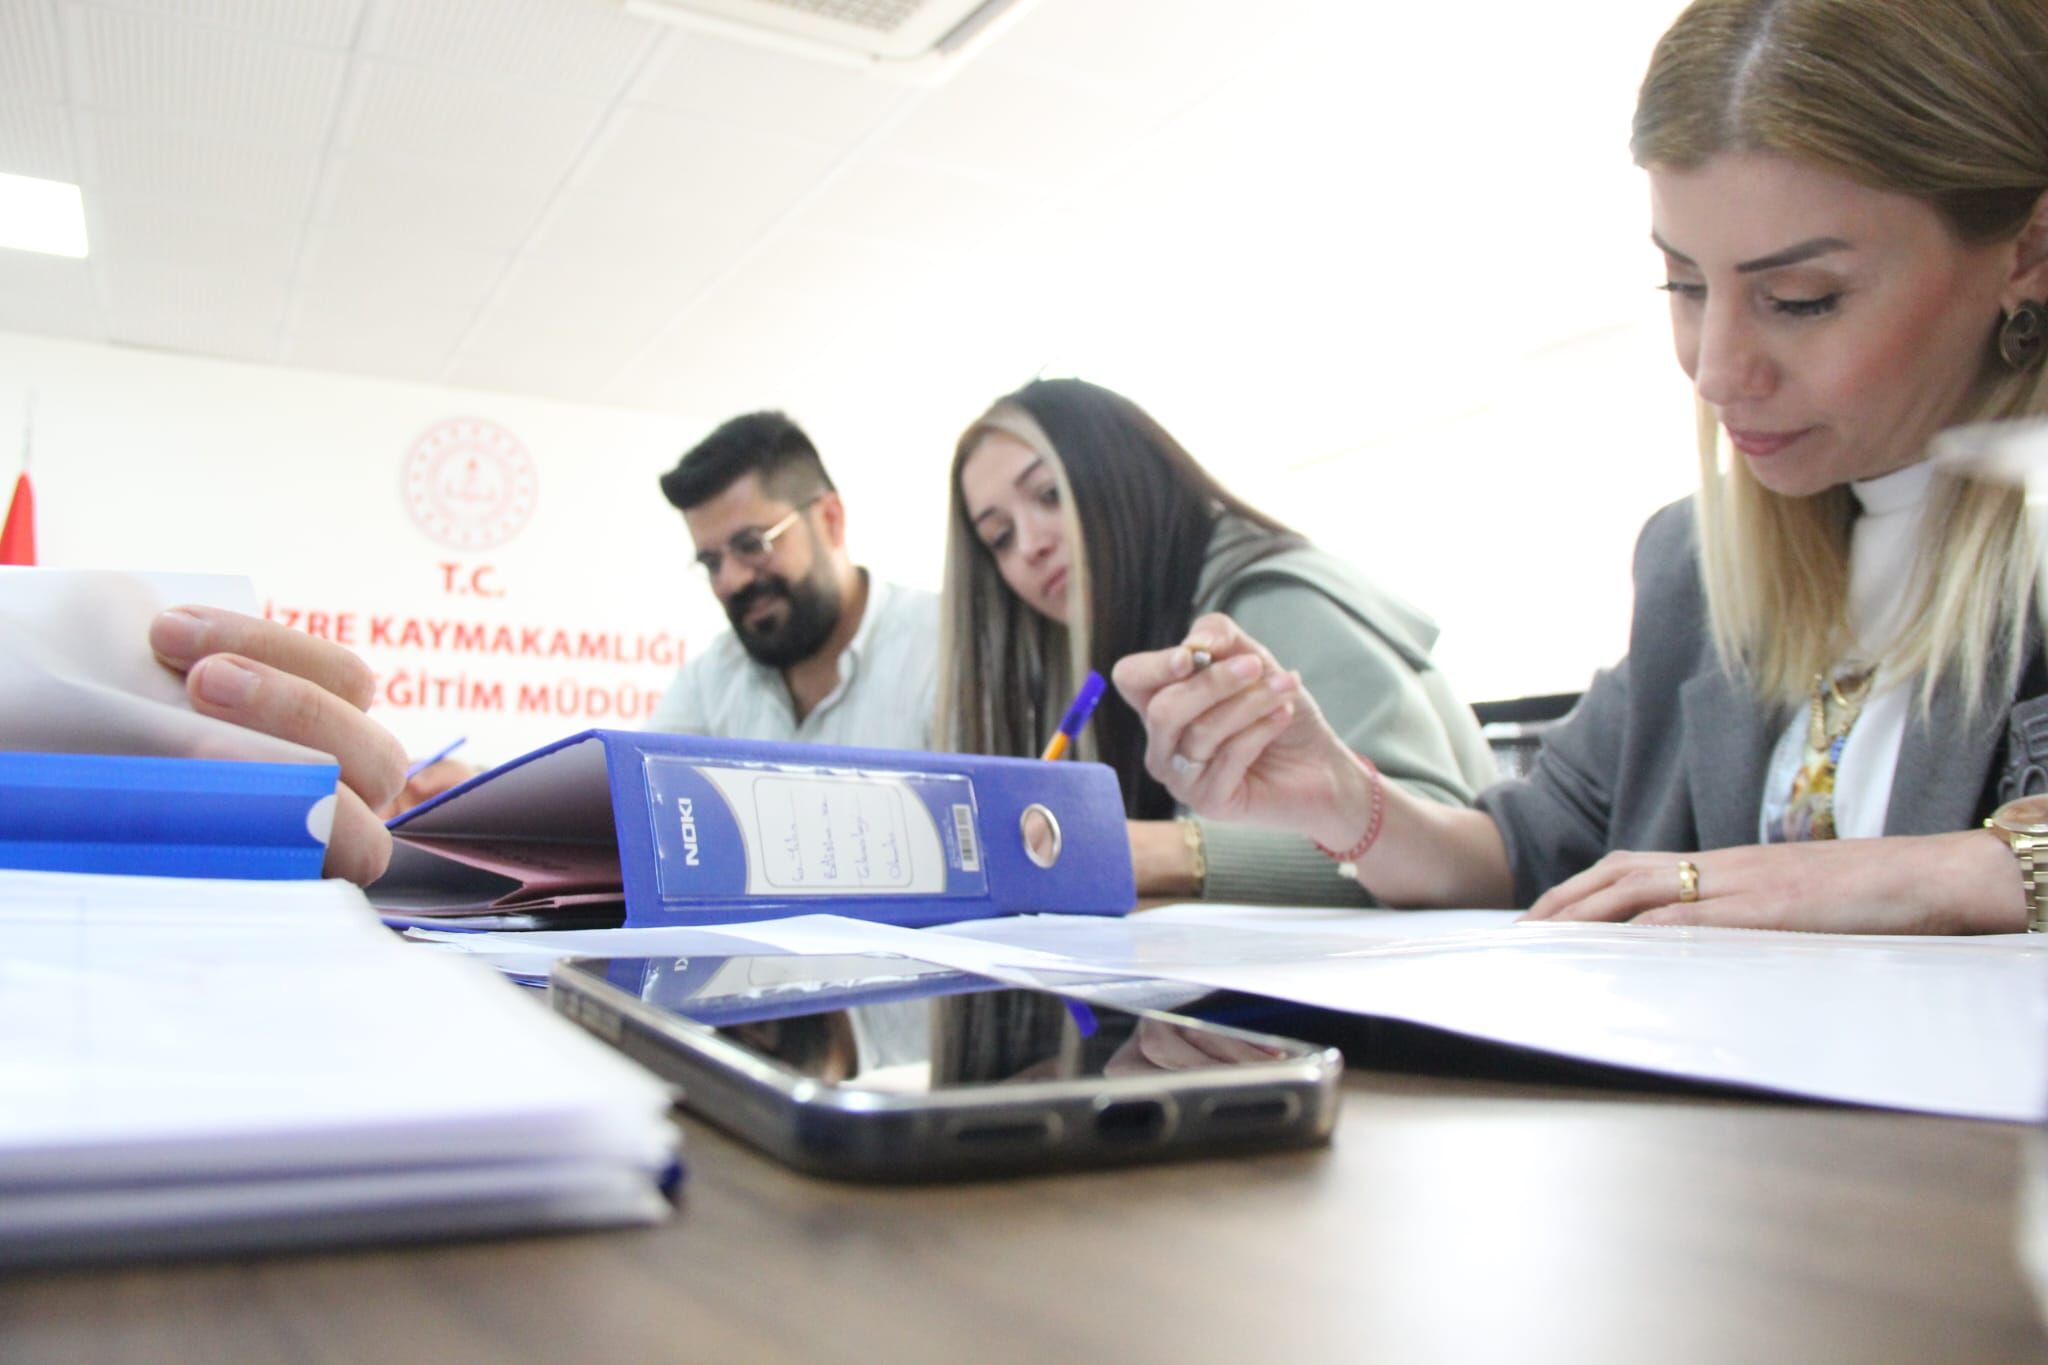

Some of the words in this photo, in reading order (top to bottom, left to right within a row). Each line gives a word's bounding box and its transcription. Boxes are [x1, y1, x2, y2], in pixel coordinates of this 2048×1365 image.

[438, 562, 505, 597] T.C.
[264, 598, 357, 645] İZRE
[370, 616, 686, 666] KAYMAKAMLIĞI
[678, 797, 699, 866] NOKI
